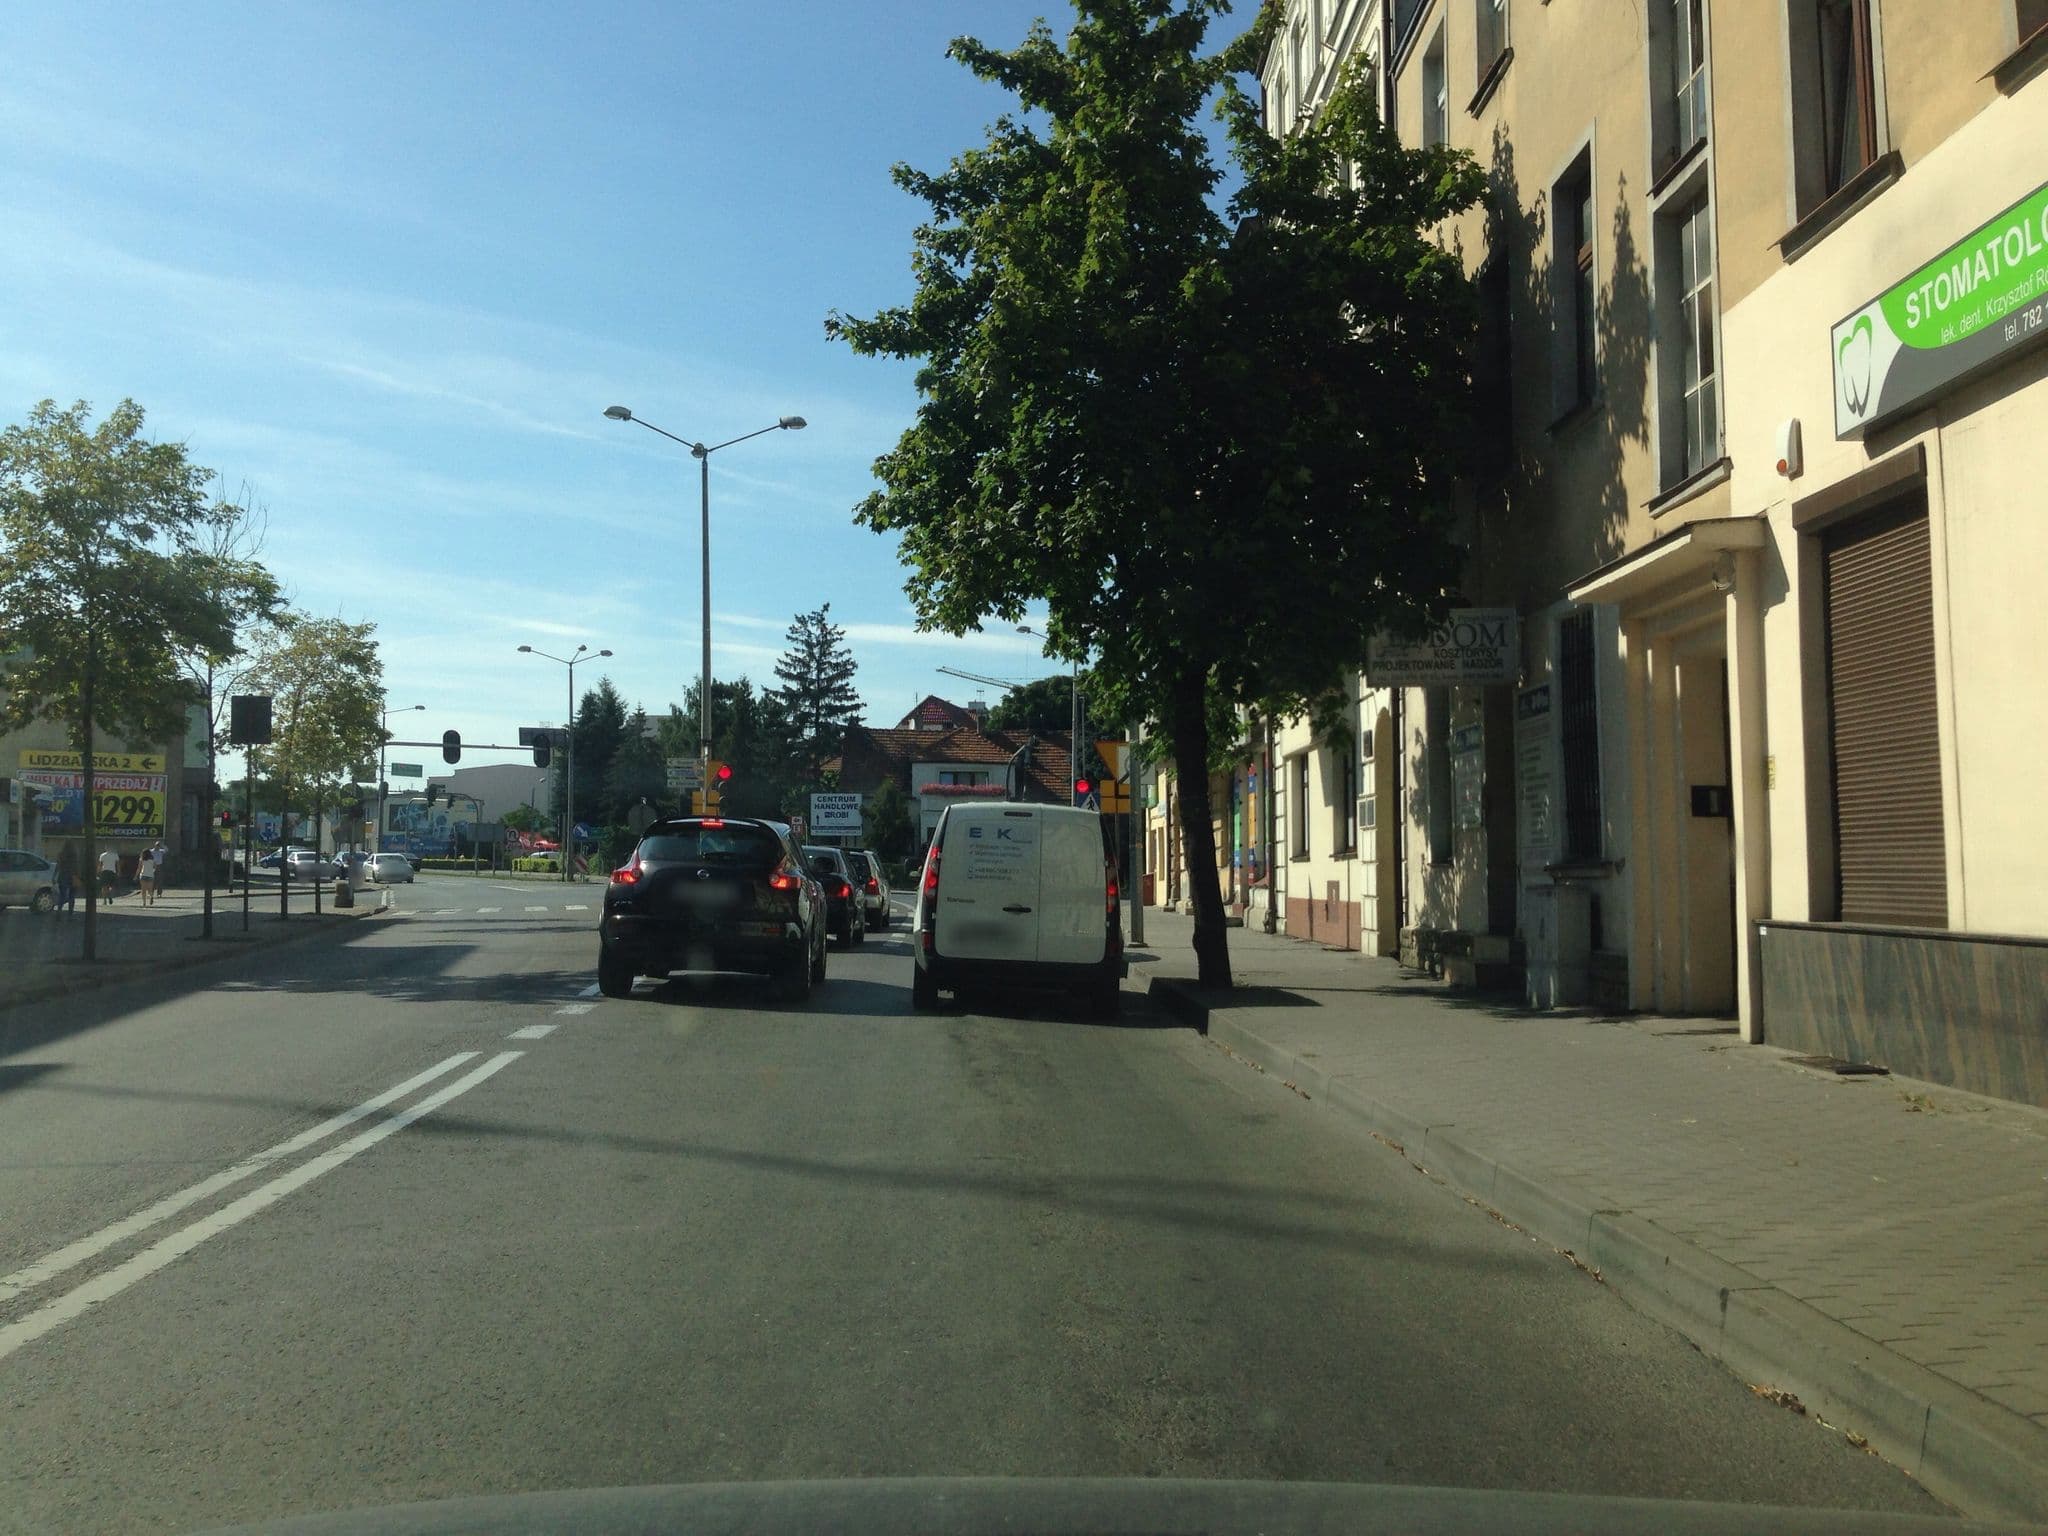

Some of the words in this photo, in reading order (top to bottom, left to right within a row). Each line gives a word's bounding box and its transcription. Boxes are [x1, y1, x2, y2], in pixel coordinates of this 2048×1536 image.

[1941, 326, 1957, 346] lek.
[1959, 308, 1984, 336] dent.
[1986, 277, 2034, 318] Krzysztof
[2004, 319, 2020, 341] tel.
[2022, 305, 2043, 331] 782
[1433, 647, 1499, 659] KOSZTORYSY
[1371, 659, 1456, 672] PROJEKTOWANIE
[29, 755, 118, 767] LIDZBASKA
[123, 758, 131, 768] 2
[816, 795, 856, 803] CENTRUM
[813, 803, 860, 811] HANDLOWE
[969, 827, 982, 838] E
[997, 828, 1012, 840] K
